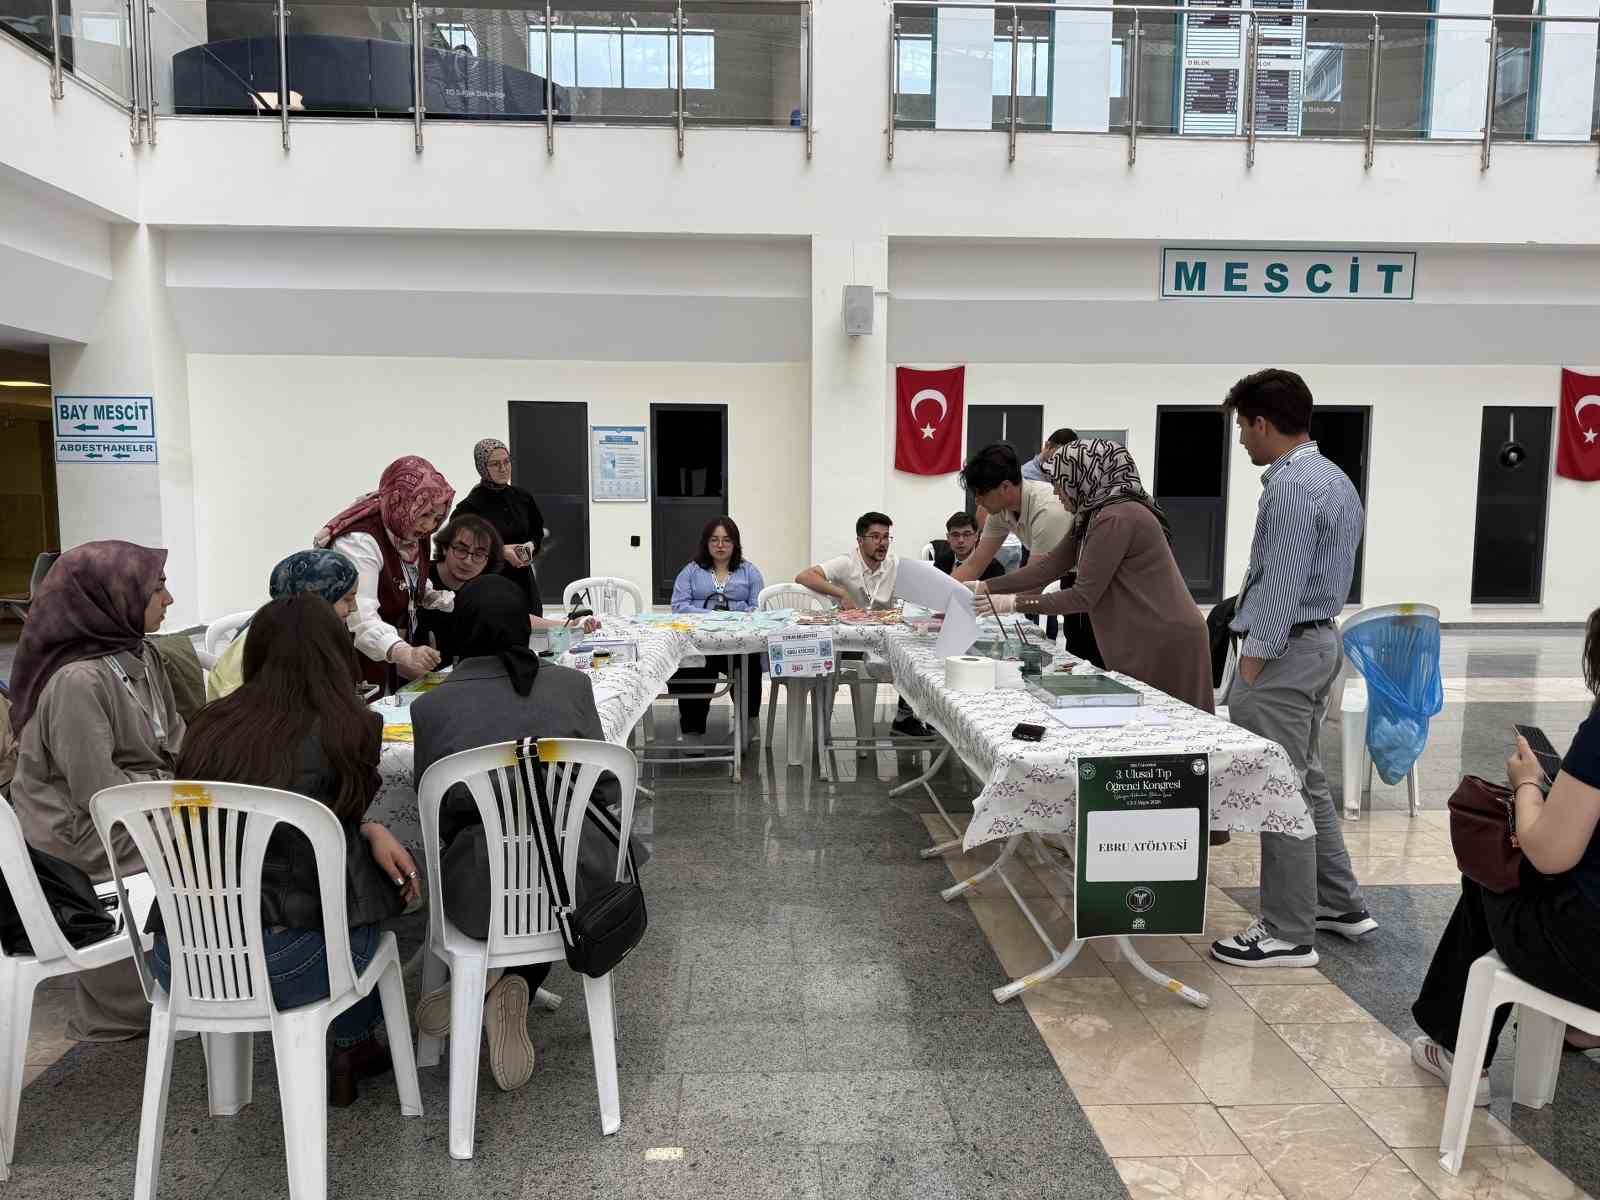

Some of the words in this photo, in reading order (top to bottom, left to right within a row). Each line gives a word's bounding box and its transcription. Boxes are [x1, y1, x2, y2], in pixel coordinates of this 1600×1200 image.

[1173, 256, 1404, 294] MESCİT
[60, 404, 89, 420] BAY
[93, 401, 149, 420] MESCİT
[60, 443, 154, 453] ABDESTHANELER
[1125, 768, 1154, 779] Ulusal
[1105, 780, 1141, 793] Öğrenci
[1143, 779, 1182, 792] Kongresi
[1098, 842, 1129, 853] EBRU
[1132, 839, 1188, 852] ATÖLYESİ
